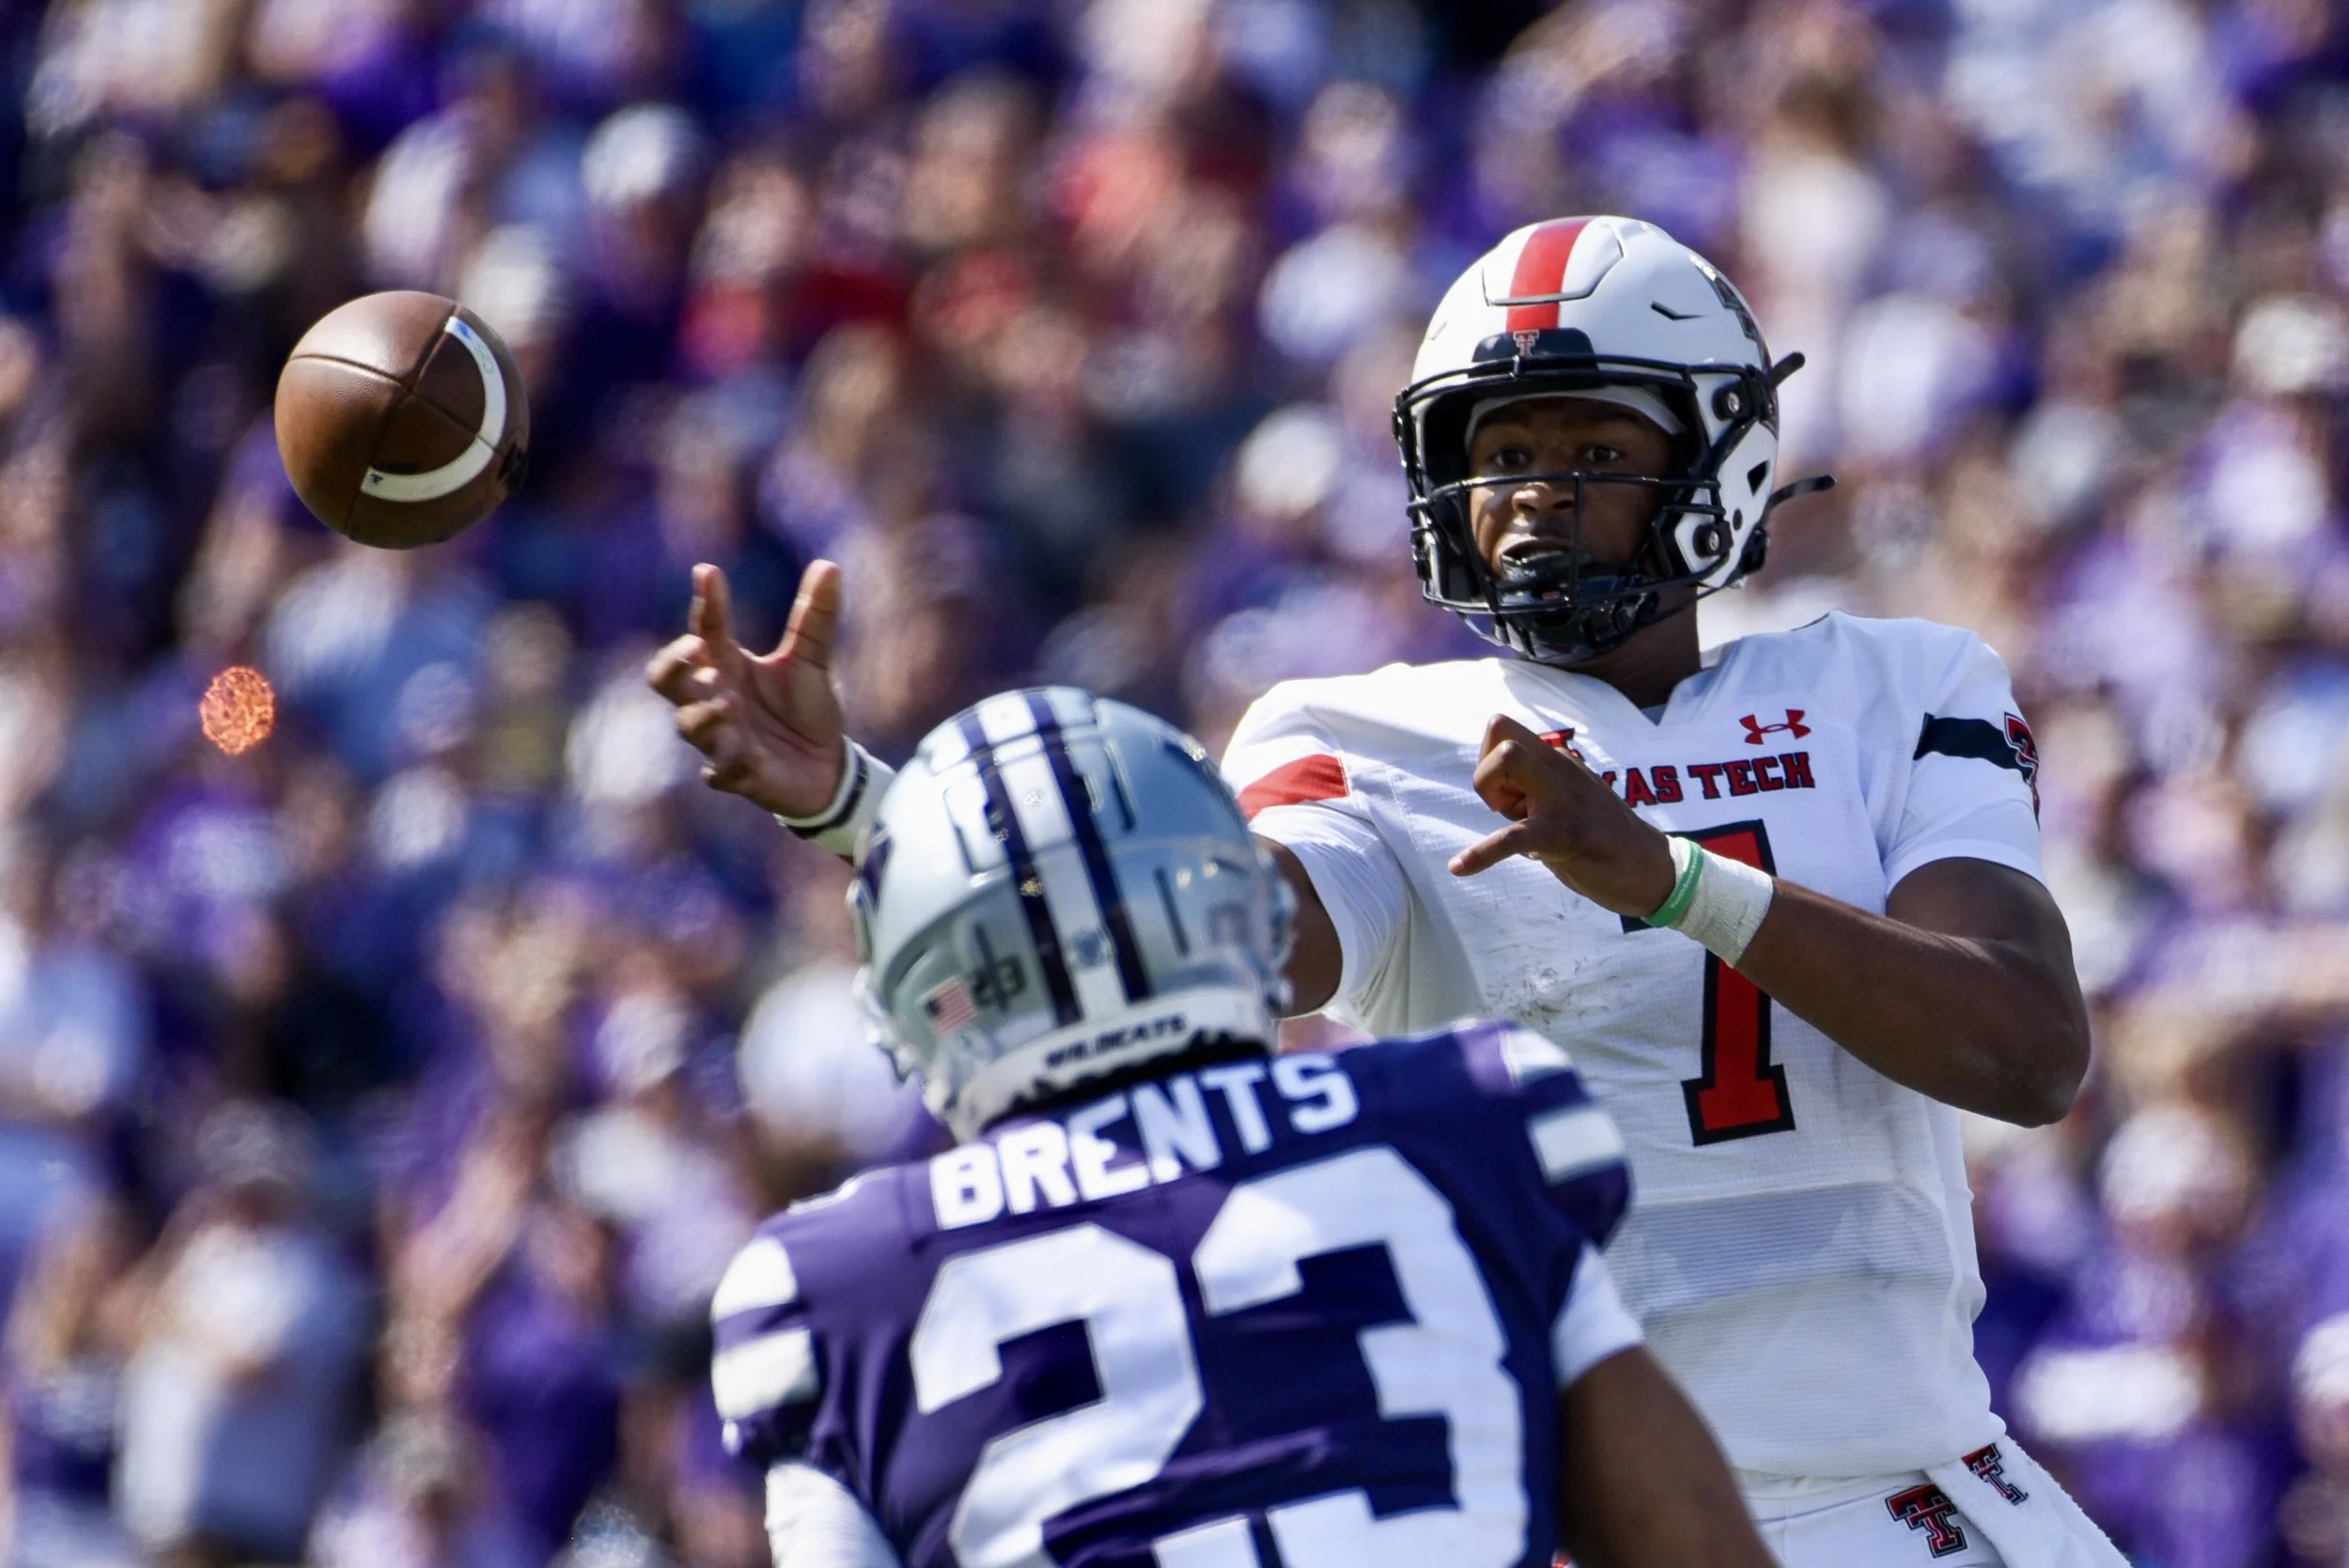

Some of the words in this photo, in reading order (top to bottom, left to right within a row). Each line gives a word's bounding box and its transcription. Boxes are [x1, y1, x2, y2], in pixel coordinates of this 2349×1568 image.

[1687, 752, 1816, 800] TECH
[929, 1051, 1361, 1232] BRENTS
[910, 1143, 1532, 1568] 23
